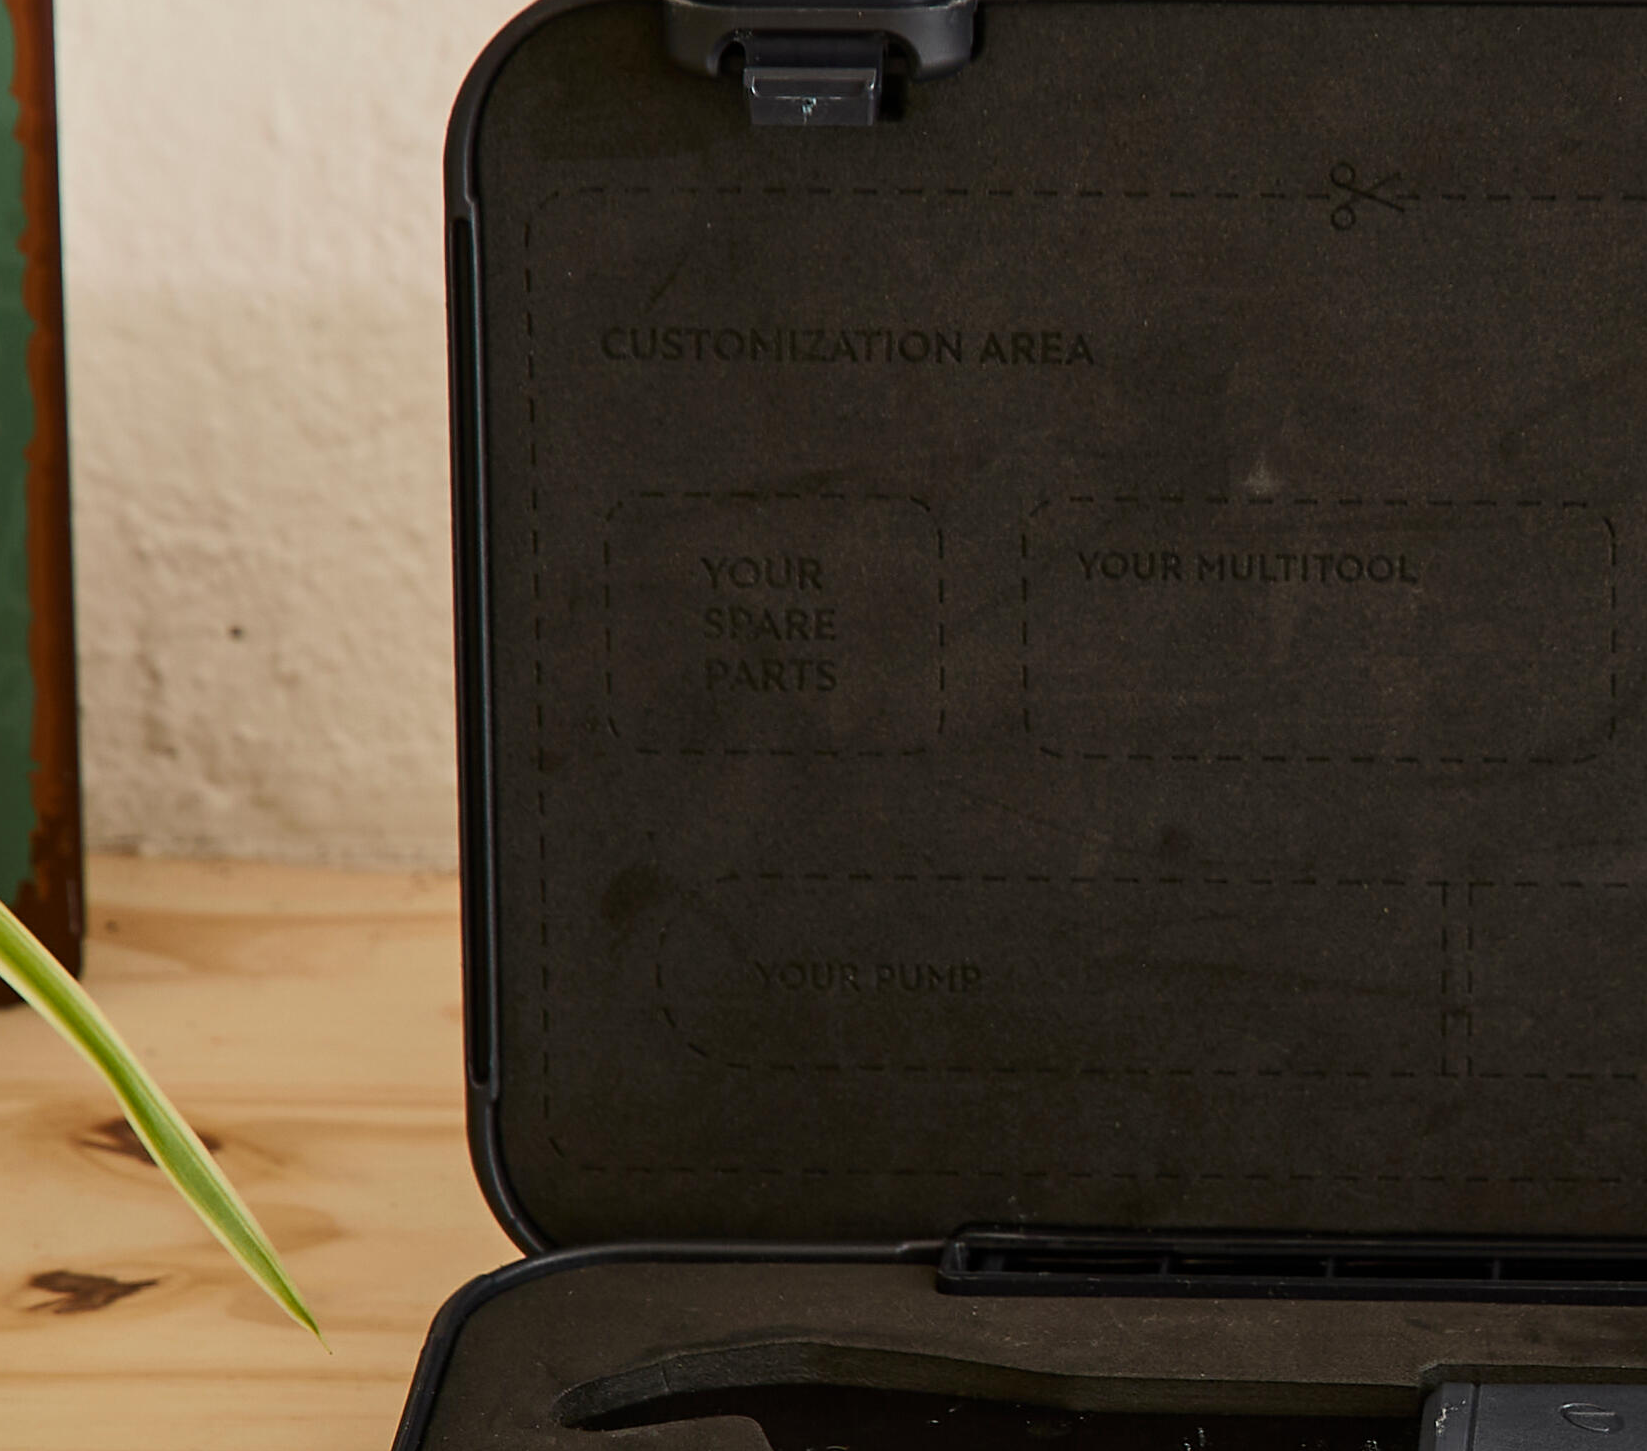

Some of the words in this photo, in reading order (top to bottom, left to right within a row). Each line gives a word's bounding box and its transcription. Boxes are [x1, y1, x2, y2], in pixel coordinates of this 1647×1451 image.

[600, 326, 964, 364] CUSTOMIZATION
[978, 330, 1096, 366] AREA
[700, 556, 823, 591] YOUR
[1076, 550, 1182, 582] YOUR
[1196, 551, 1417, 586] MULTITOOL
[702, 607, 837, 642] SPARE
[703, 658, 837, 693] PARTS
[754, 960, 859, 992] YOUR
[874, 962, 983, 993] PUMP
